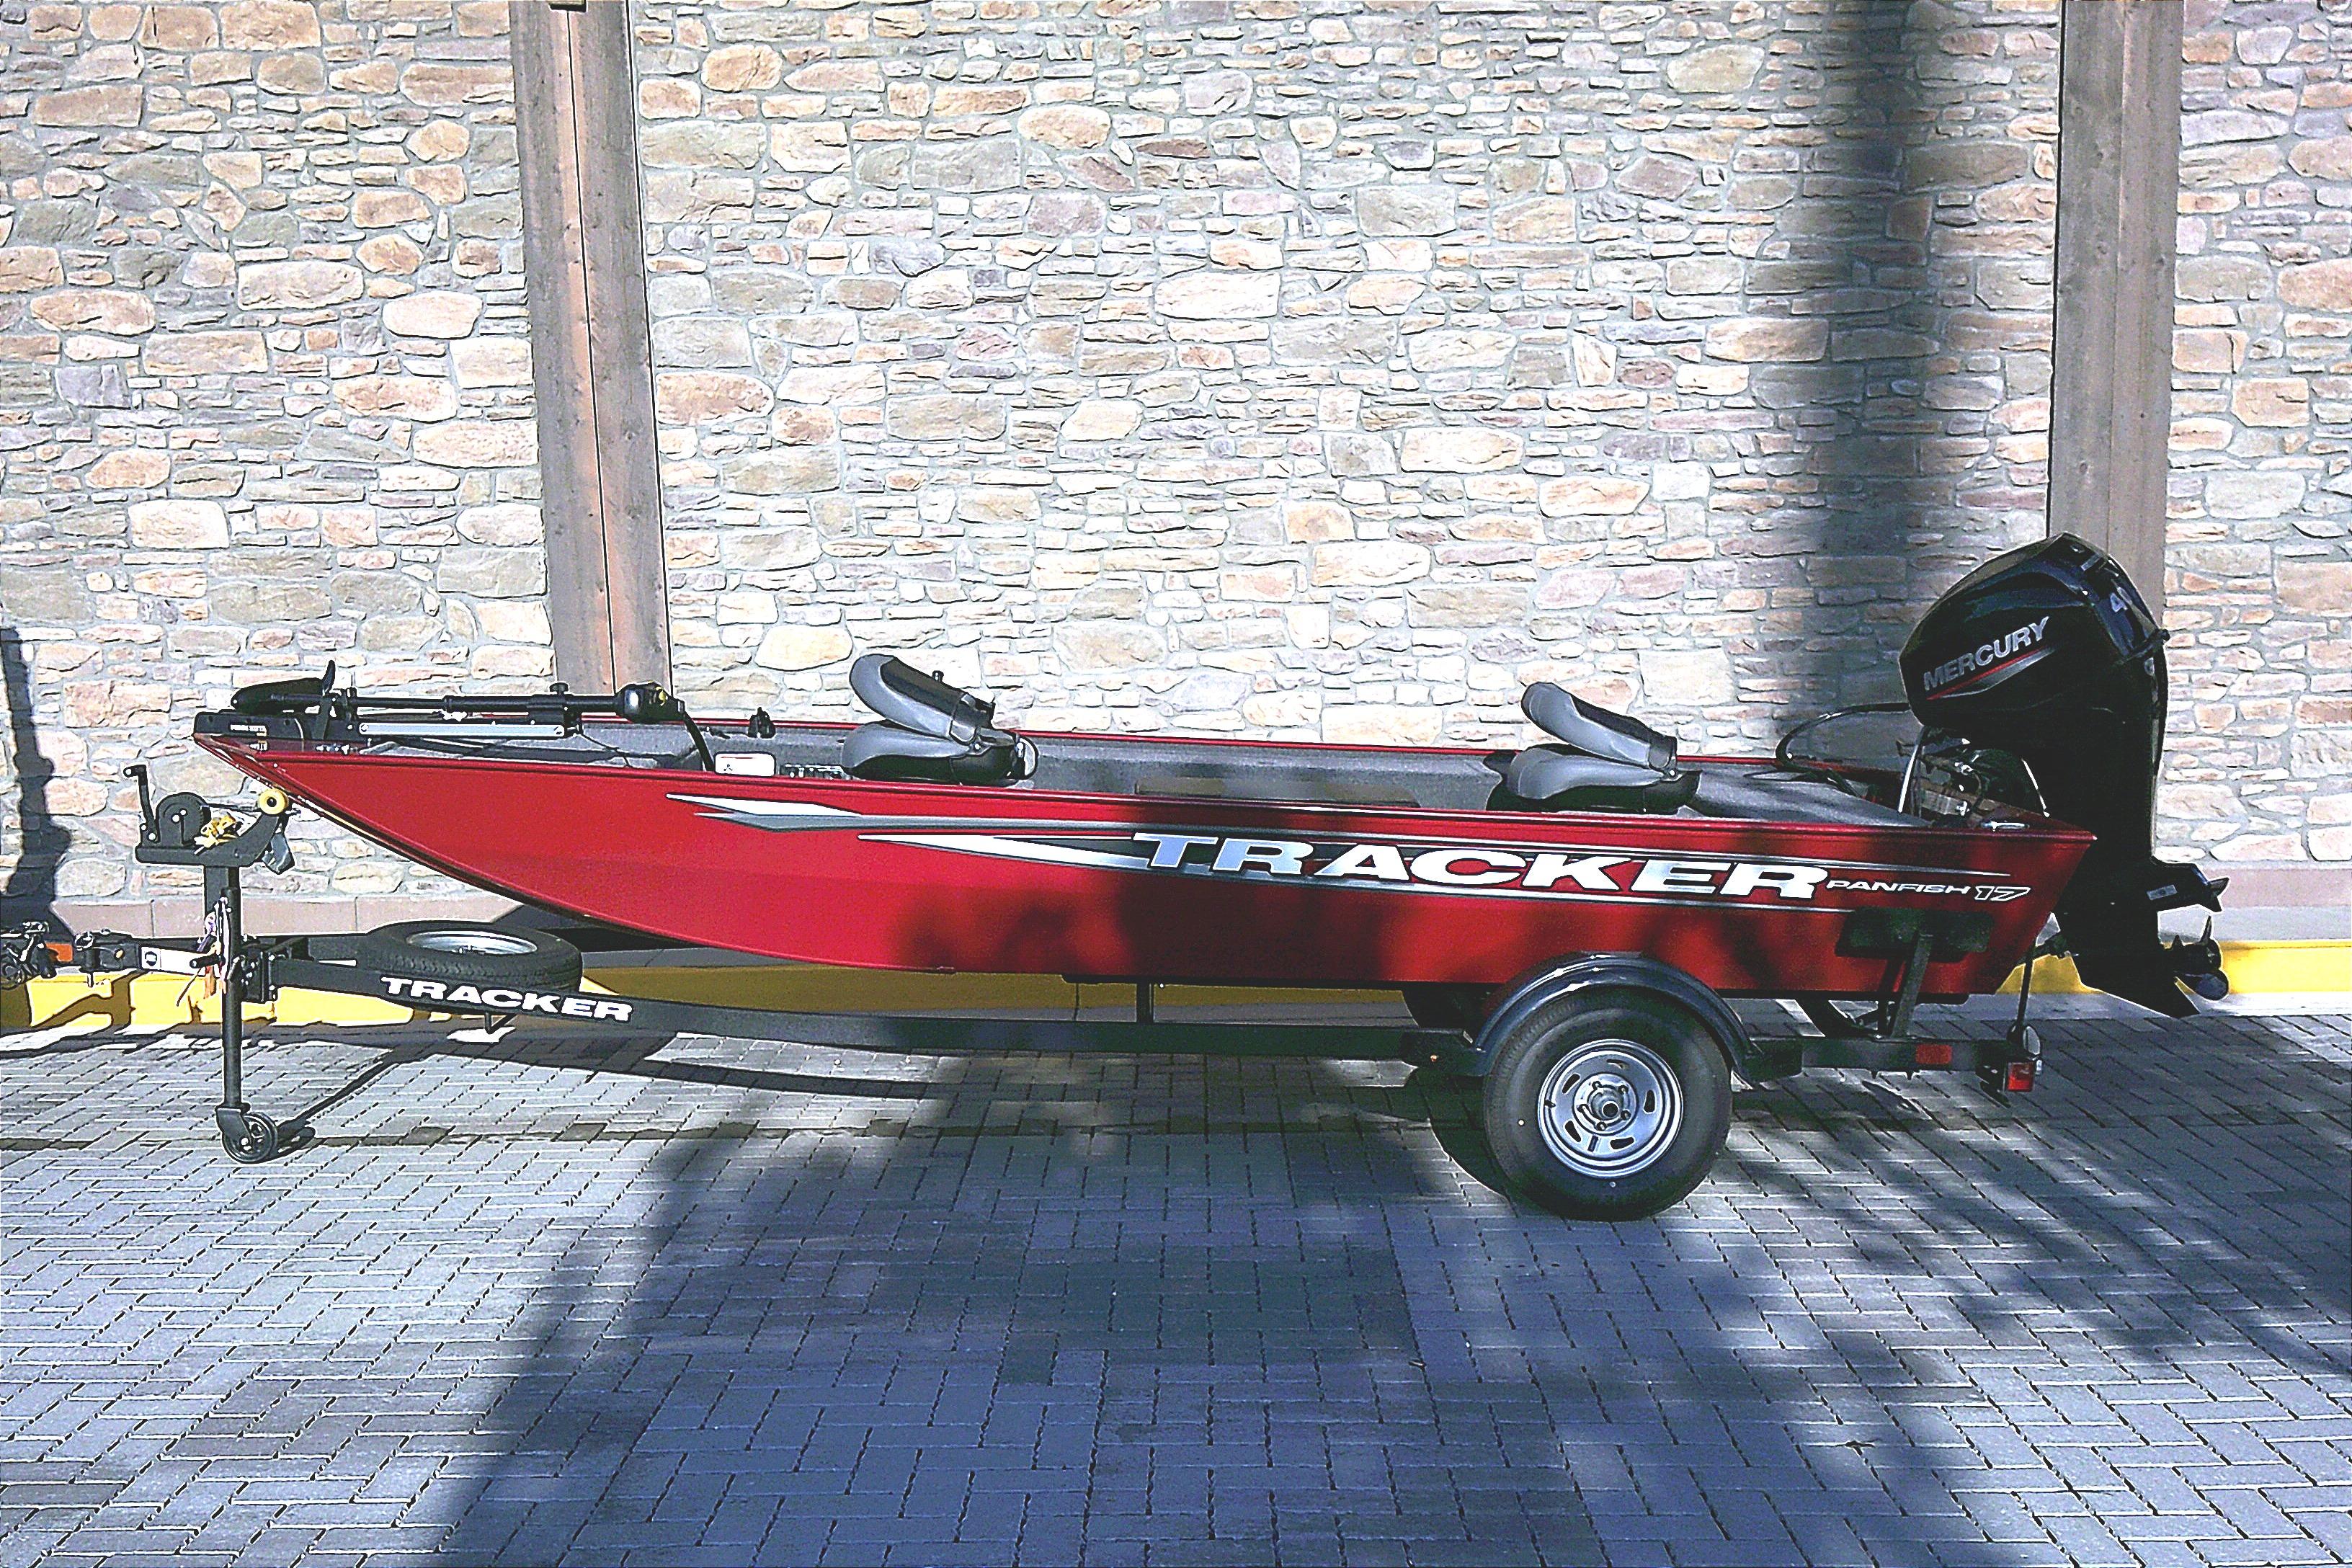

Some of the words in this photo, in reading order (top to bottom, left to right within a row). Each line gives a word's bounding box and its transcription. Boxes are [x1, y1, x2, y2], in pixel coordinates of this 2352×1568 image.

[1923, 616, 2049, 690] MERCURY
[1133, 832, 1828, 899] TRACKER
[1826, 880, 1971, 894] PANFISH
[1974, 886, 2031, 901] 17
[380, 976, 632, 1021] TRACKER
